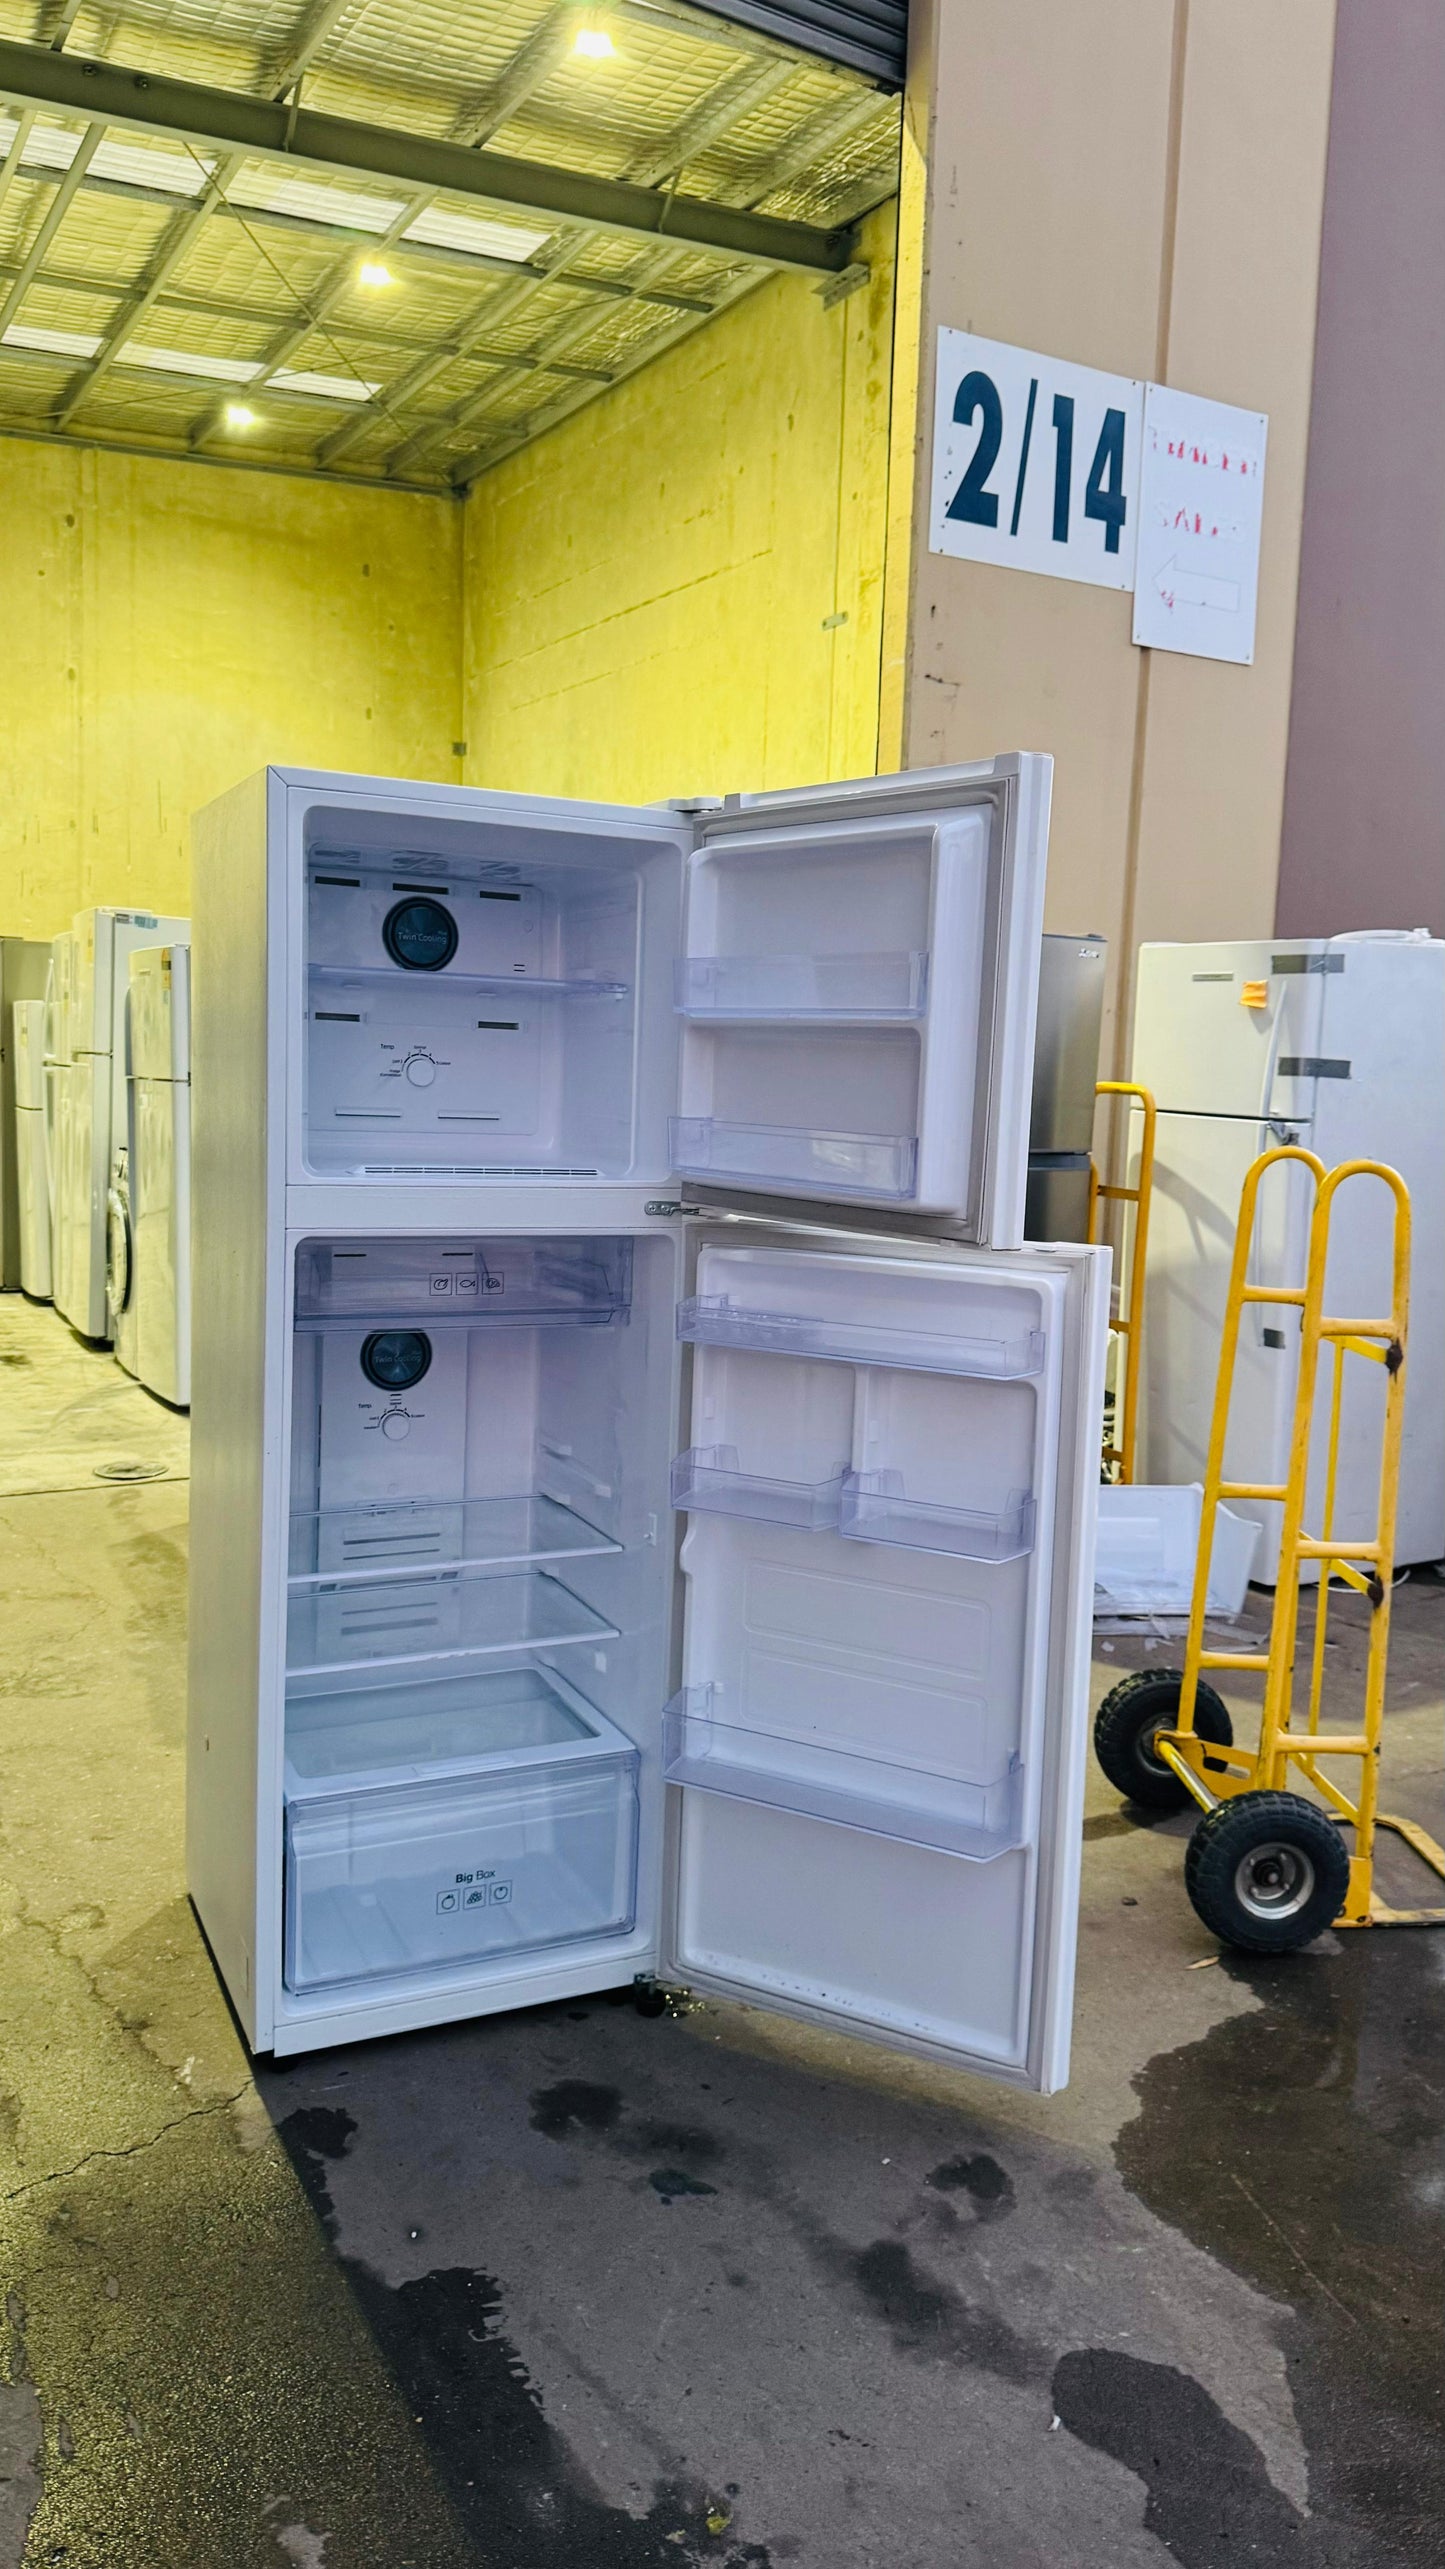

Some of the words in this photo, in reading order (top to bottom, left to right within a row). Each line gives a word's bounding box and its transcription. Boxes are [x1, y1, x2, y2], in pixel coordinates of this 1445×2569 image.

[945, 371, 1127, 554] 2/14
[398, 931, 417, 941] Twin
[418, 933, 447, 946] Cooling
[455, 1873, 474, 1883] Big
[476, 1870, 496, 1880] Box
